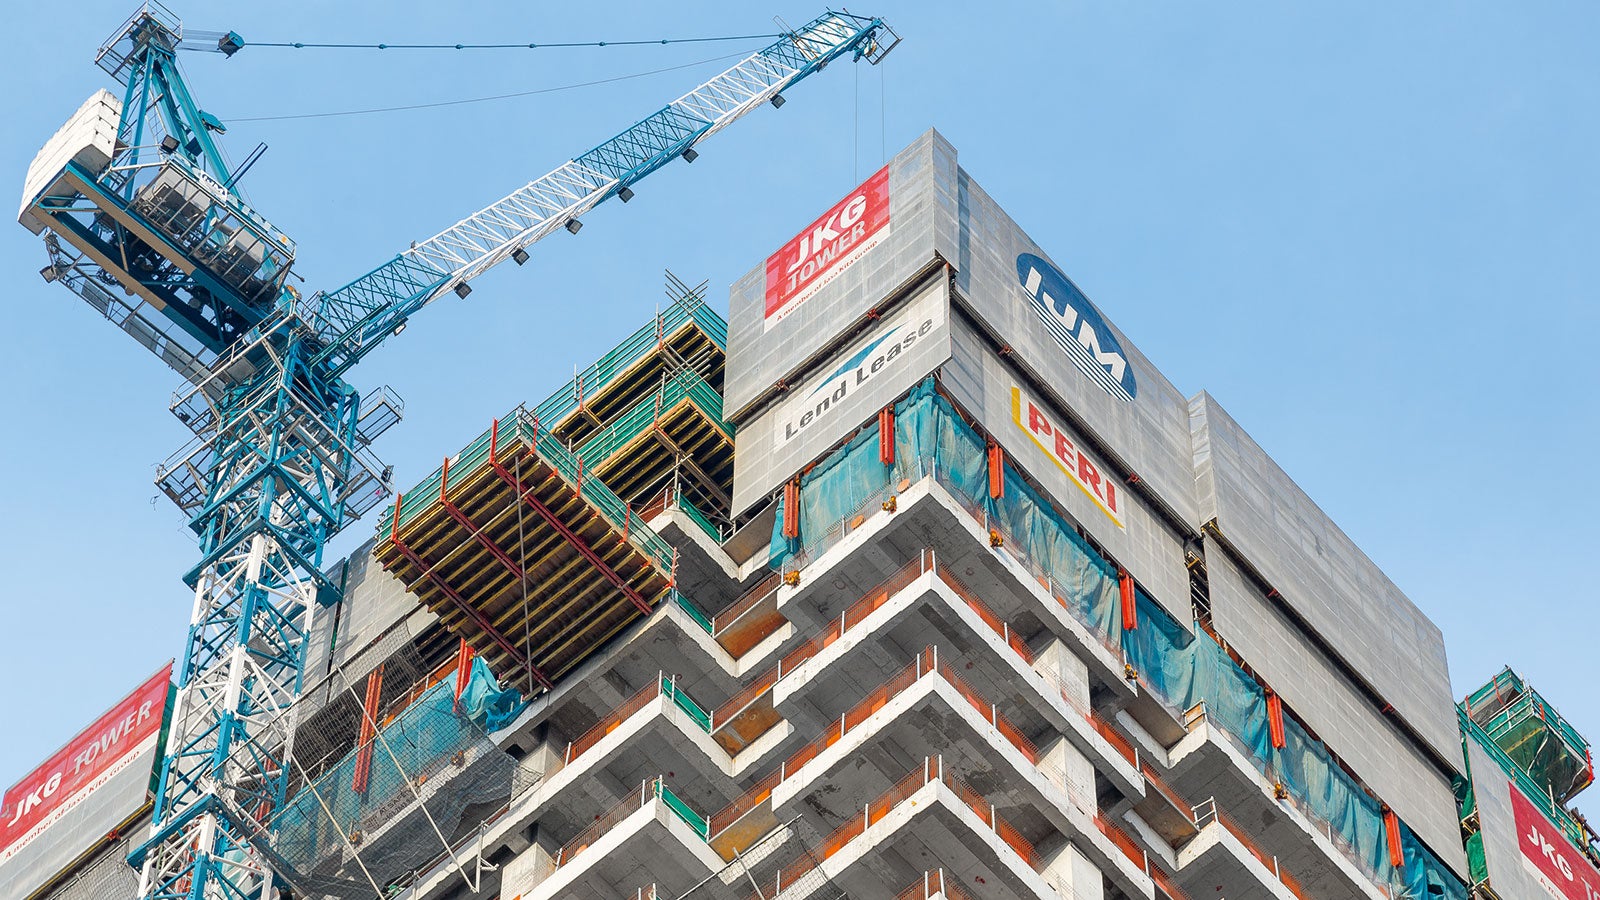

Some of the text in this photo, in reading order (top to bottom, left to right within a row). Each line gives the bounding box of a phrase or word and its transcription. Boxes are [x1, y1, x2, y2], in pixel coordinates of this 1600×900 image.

[787, 195, 867, 273] JKG
[787, 220, 866, 291] TOWER
[784, 291, 813, 316] member
[839, 259, 854, 272] Kita
[855, 240, 878, 260] Group
[1025, 266, 1127, 384] IJM
[785, 319, 933, 441] Lend Lease
[1028, 401, 1117, 513] PERI
[74, 700, 152, 775] TOWER
[7, 772, 62, 828] JKG
[13, 819, 52, 852] member
[54, 808, 65, 820] of
[88, 776, 108, 794] Kita
[110, 751, 140, 776] Group
[1527, 824, 1574, 882] JKG
